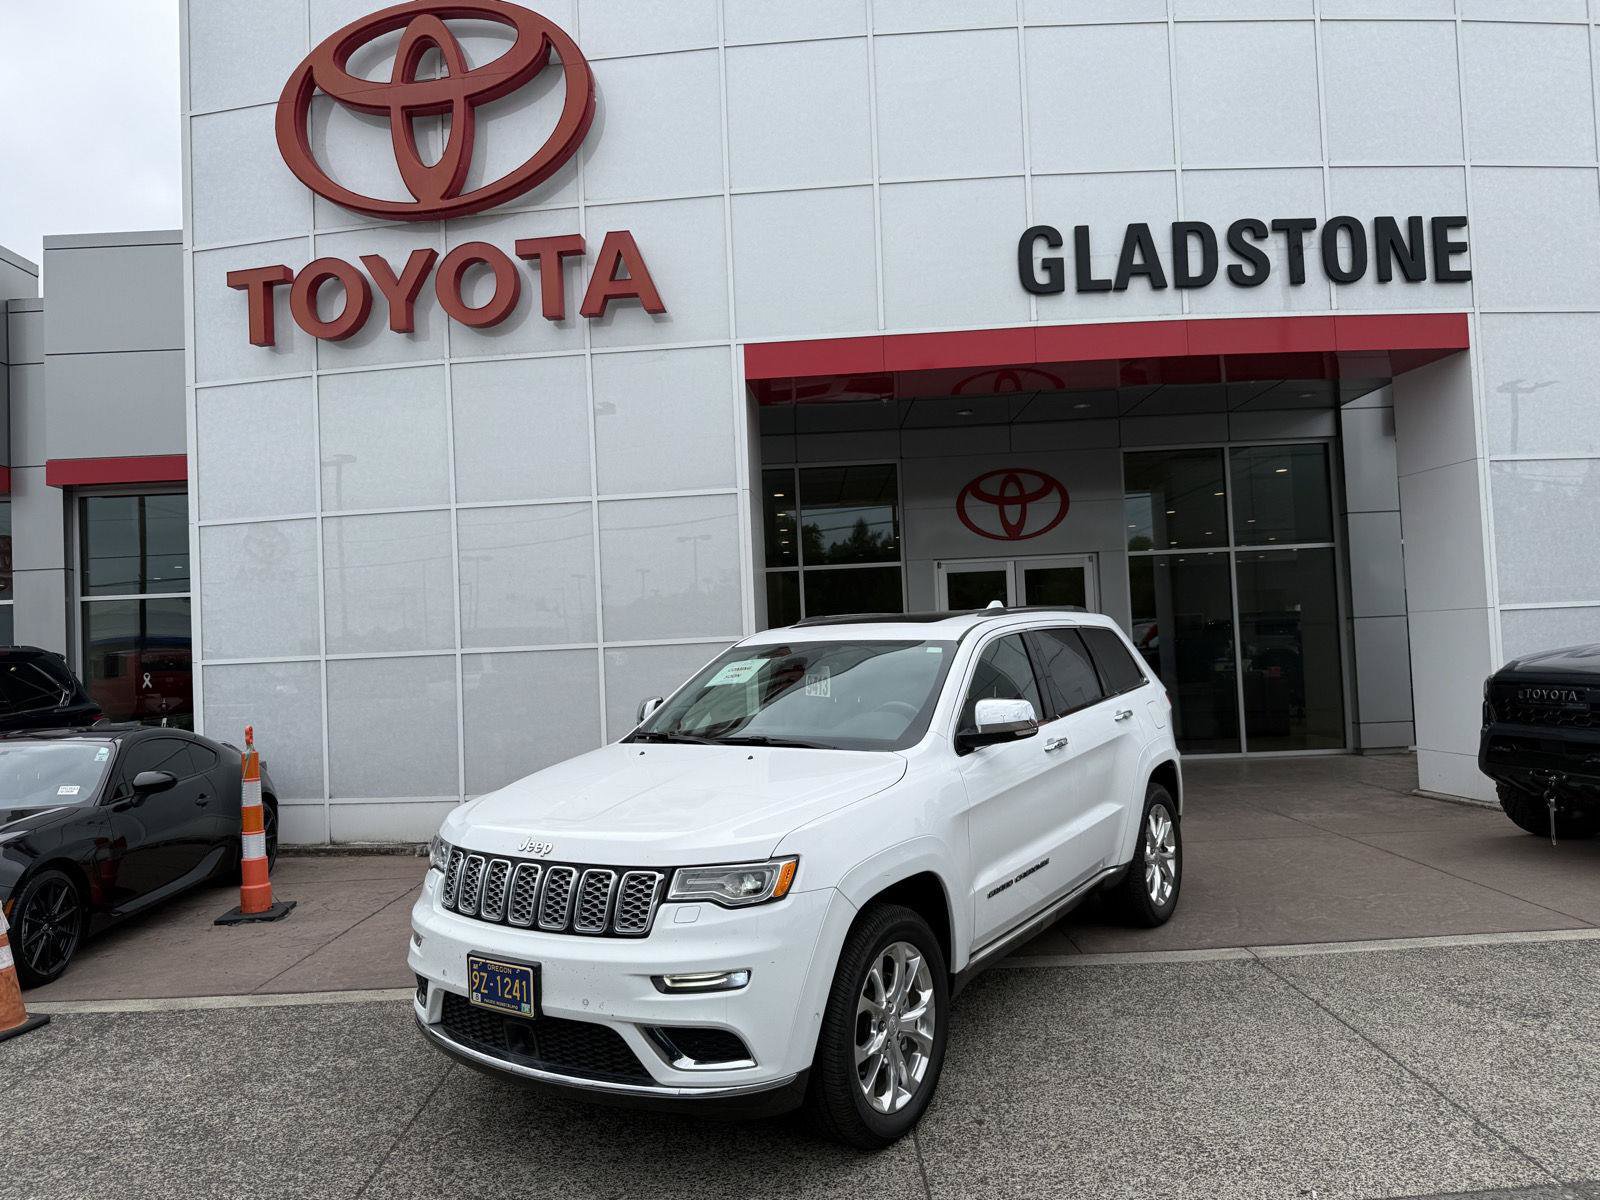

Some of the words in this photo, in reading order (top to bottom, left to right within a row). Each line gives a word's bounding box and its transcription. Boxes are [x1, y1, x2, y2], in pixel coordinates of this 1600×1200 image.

[1018, 215, 1472, 295] GLADSTONE
[226, 230, 667, 347] TOYOTA
[1524, 688, 1577, 702] TOYOTA
[518, 832, 553, 857] Jeep
[487, 963, 512, 975] OREGON
